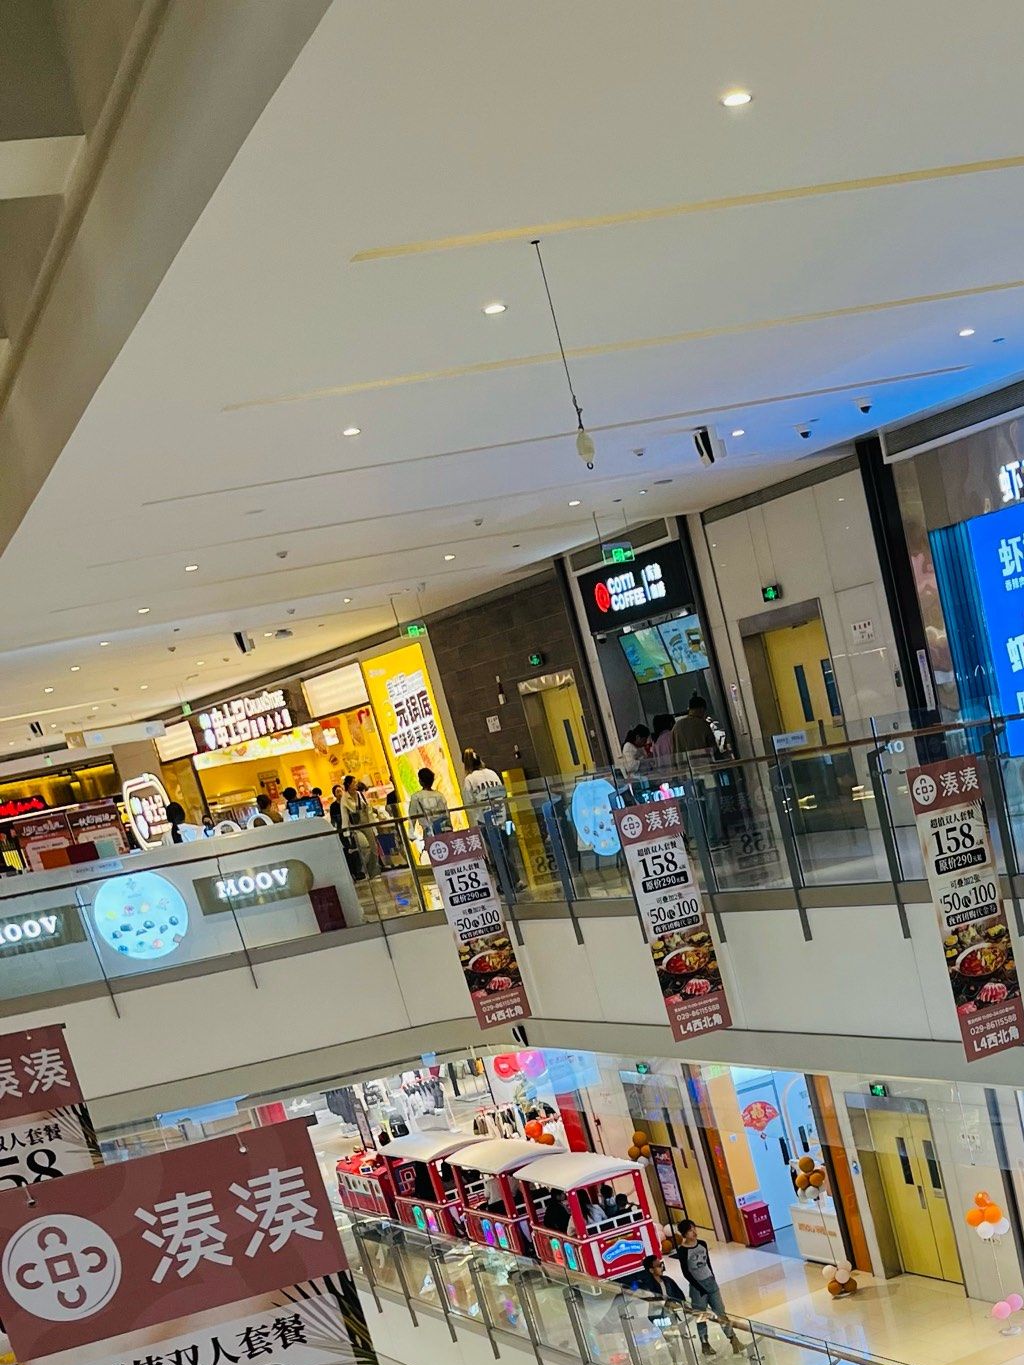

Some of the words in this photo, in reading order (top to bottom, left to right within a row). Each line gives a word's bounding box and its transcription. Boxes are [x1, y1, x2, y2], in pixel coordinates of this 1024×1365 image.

[606, 571, 636, 595] COTTI
[610, 586, 647, 612] COFFEE
[930, 810, 975, 829] 超值双人套餐
[216, 867, 289, 899] MOOV
[485, 1006, 524, 1024] L4西北角
[680, 1013, 723, 1035] L4西北角
[974, 1026, 1020, 1052] L4西北角
[133, 1165, 324, 1285] 湊湊
